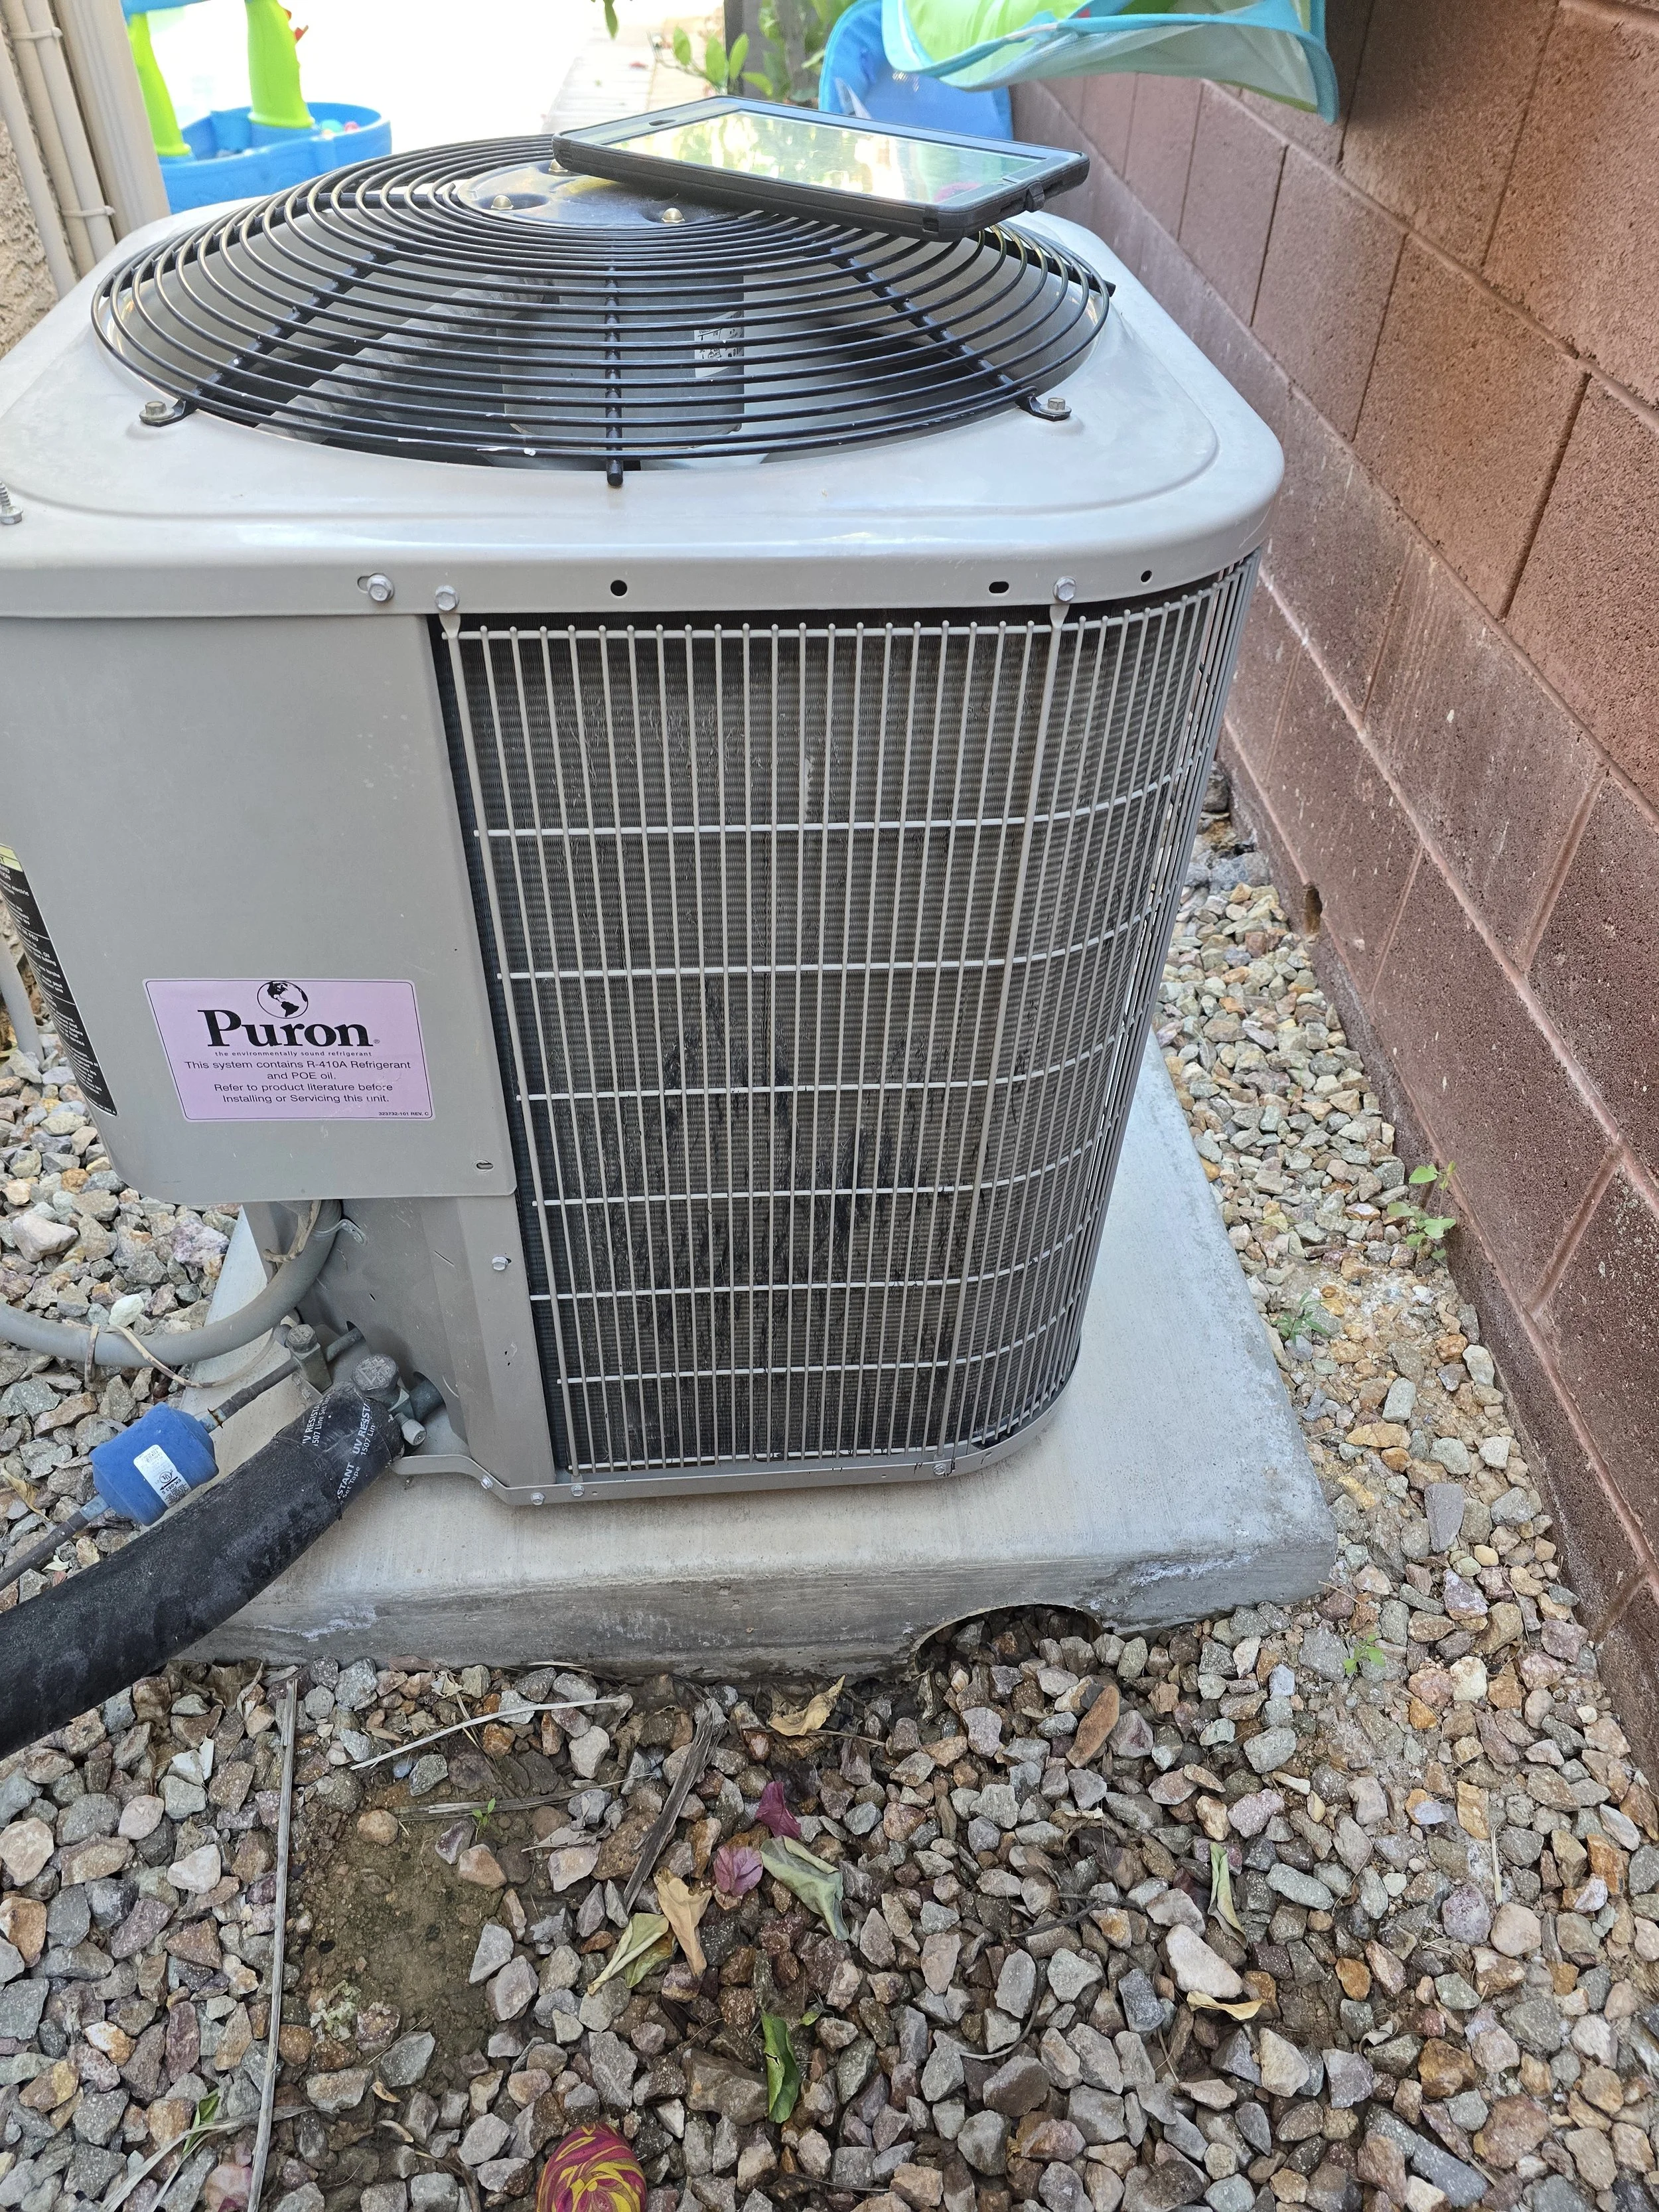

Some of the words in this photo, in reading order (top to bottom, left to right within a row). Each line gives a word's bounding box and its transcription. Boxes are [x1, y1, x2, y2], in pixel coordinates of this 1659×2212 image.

[197, 1009, 374, 1047] Puron
[351, 1061, 411, 1070] Refrigerant
[261, 1084, 305, 1092] product
[223, 1095, 272, 1104] Installing
[290, 1095, 340, 1104] Servicing
[319, 1406, 327, 1416] Set
[315, 1416, 324, 1430] Line
[352, 1438, 362, 1455] UV
[360, 1438, 371, 1455] 1507
[342, 1487, 352, 1499] Set
[348, 1466, 361, 1485] Tape
